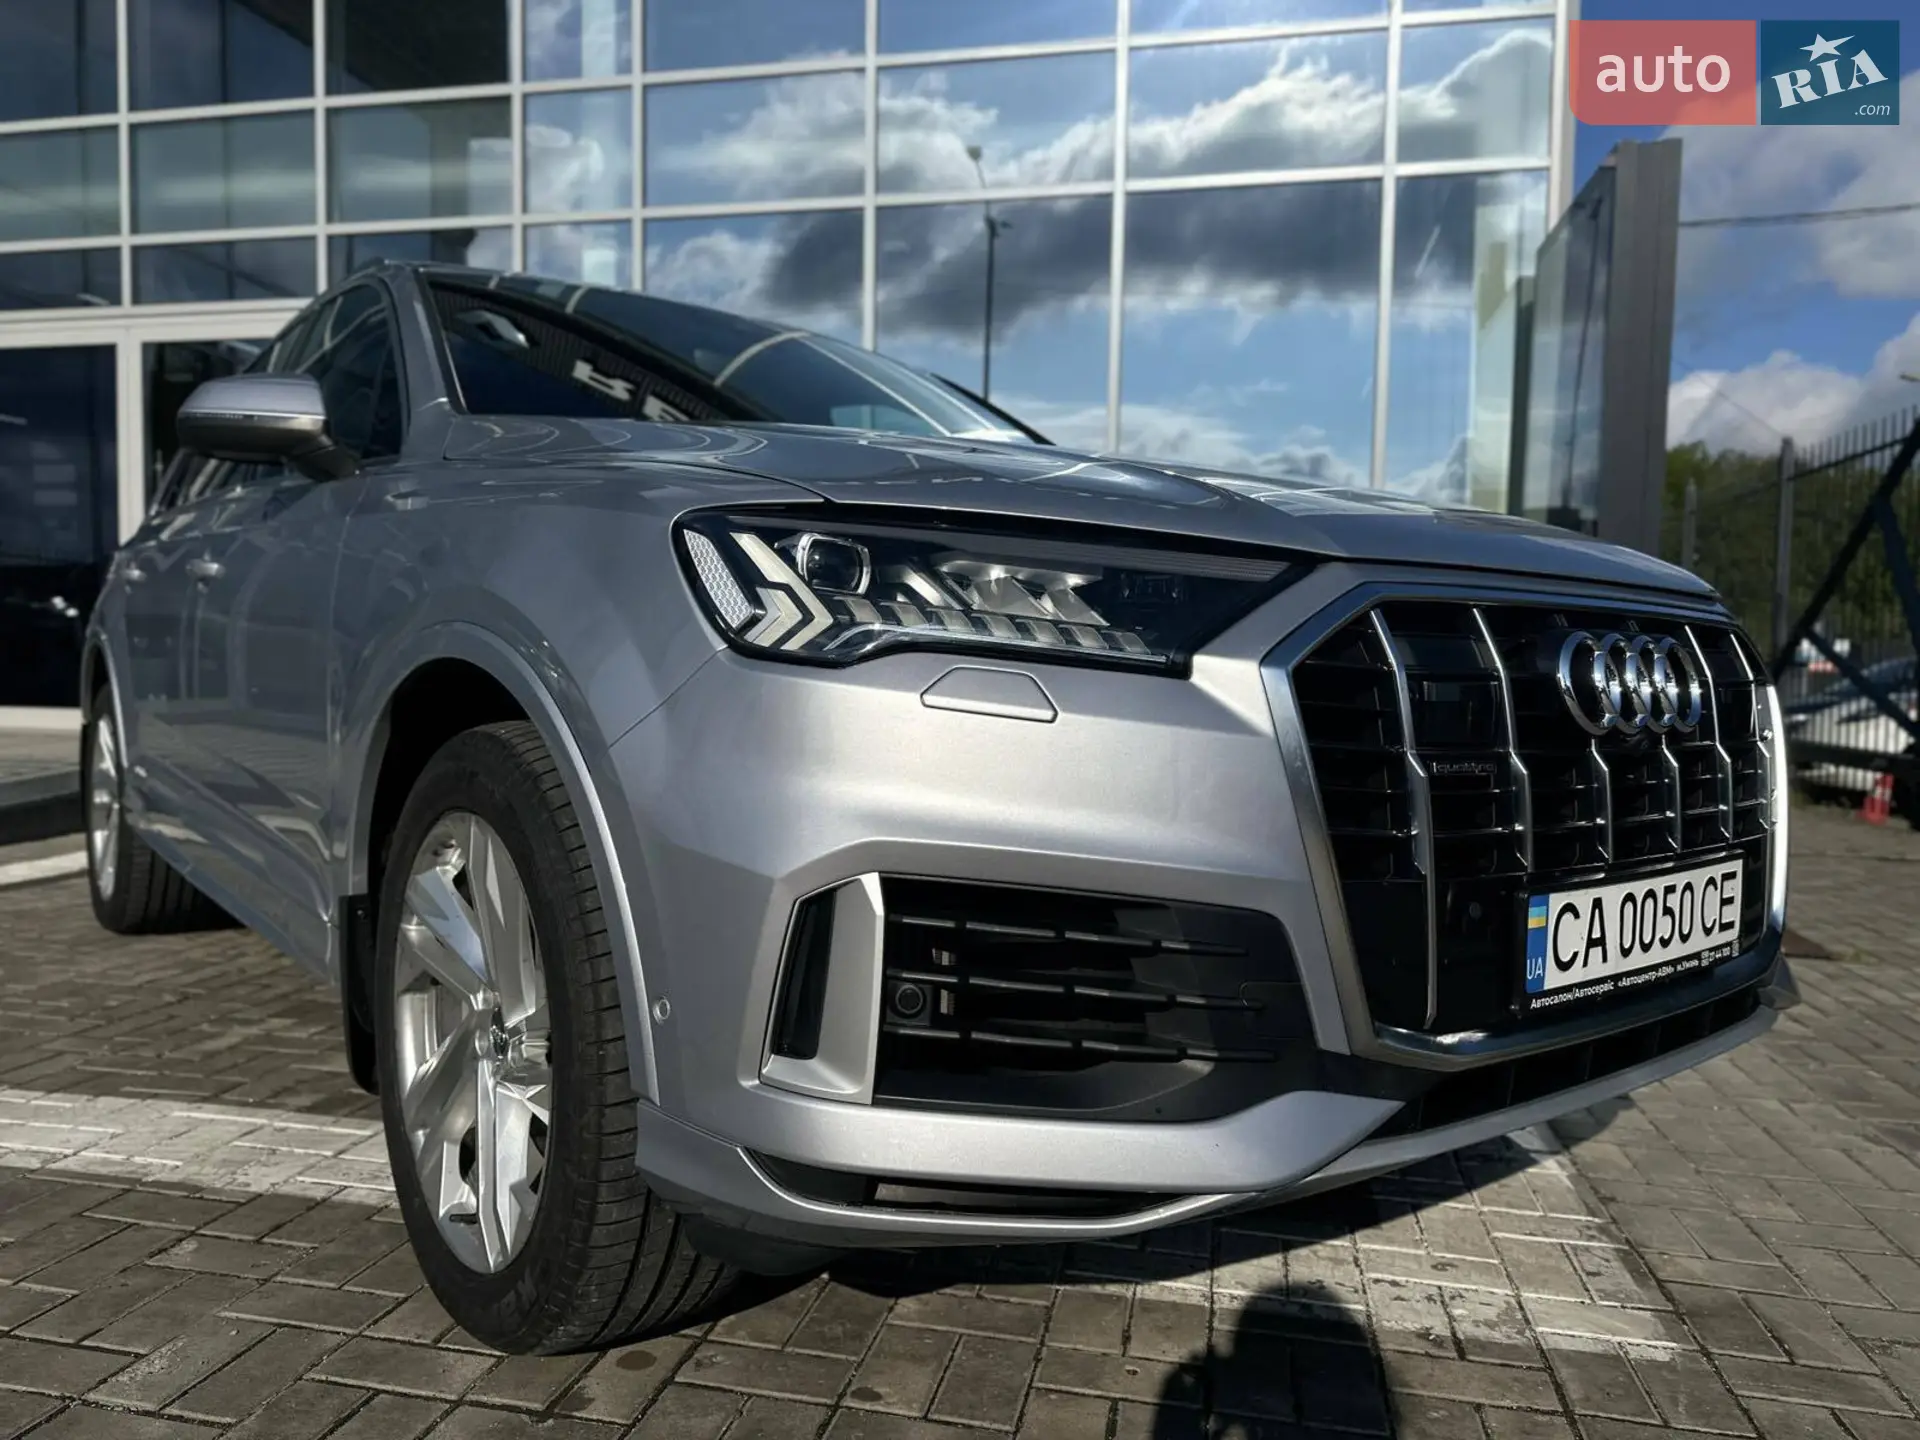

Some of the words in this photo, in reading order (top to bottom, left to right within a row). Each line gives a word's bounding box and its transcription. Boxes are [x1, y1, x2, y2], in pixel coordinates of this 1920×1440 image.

[1552, 897, 1608, 972] CA
[1619, 881, 1694, 958] 0050
[1700, 871, 1738, 937] CE
[1527, 958, 1543, 980] UA
